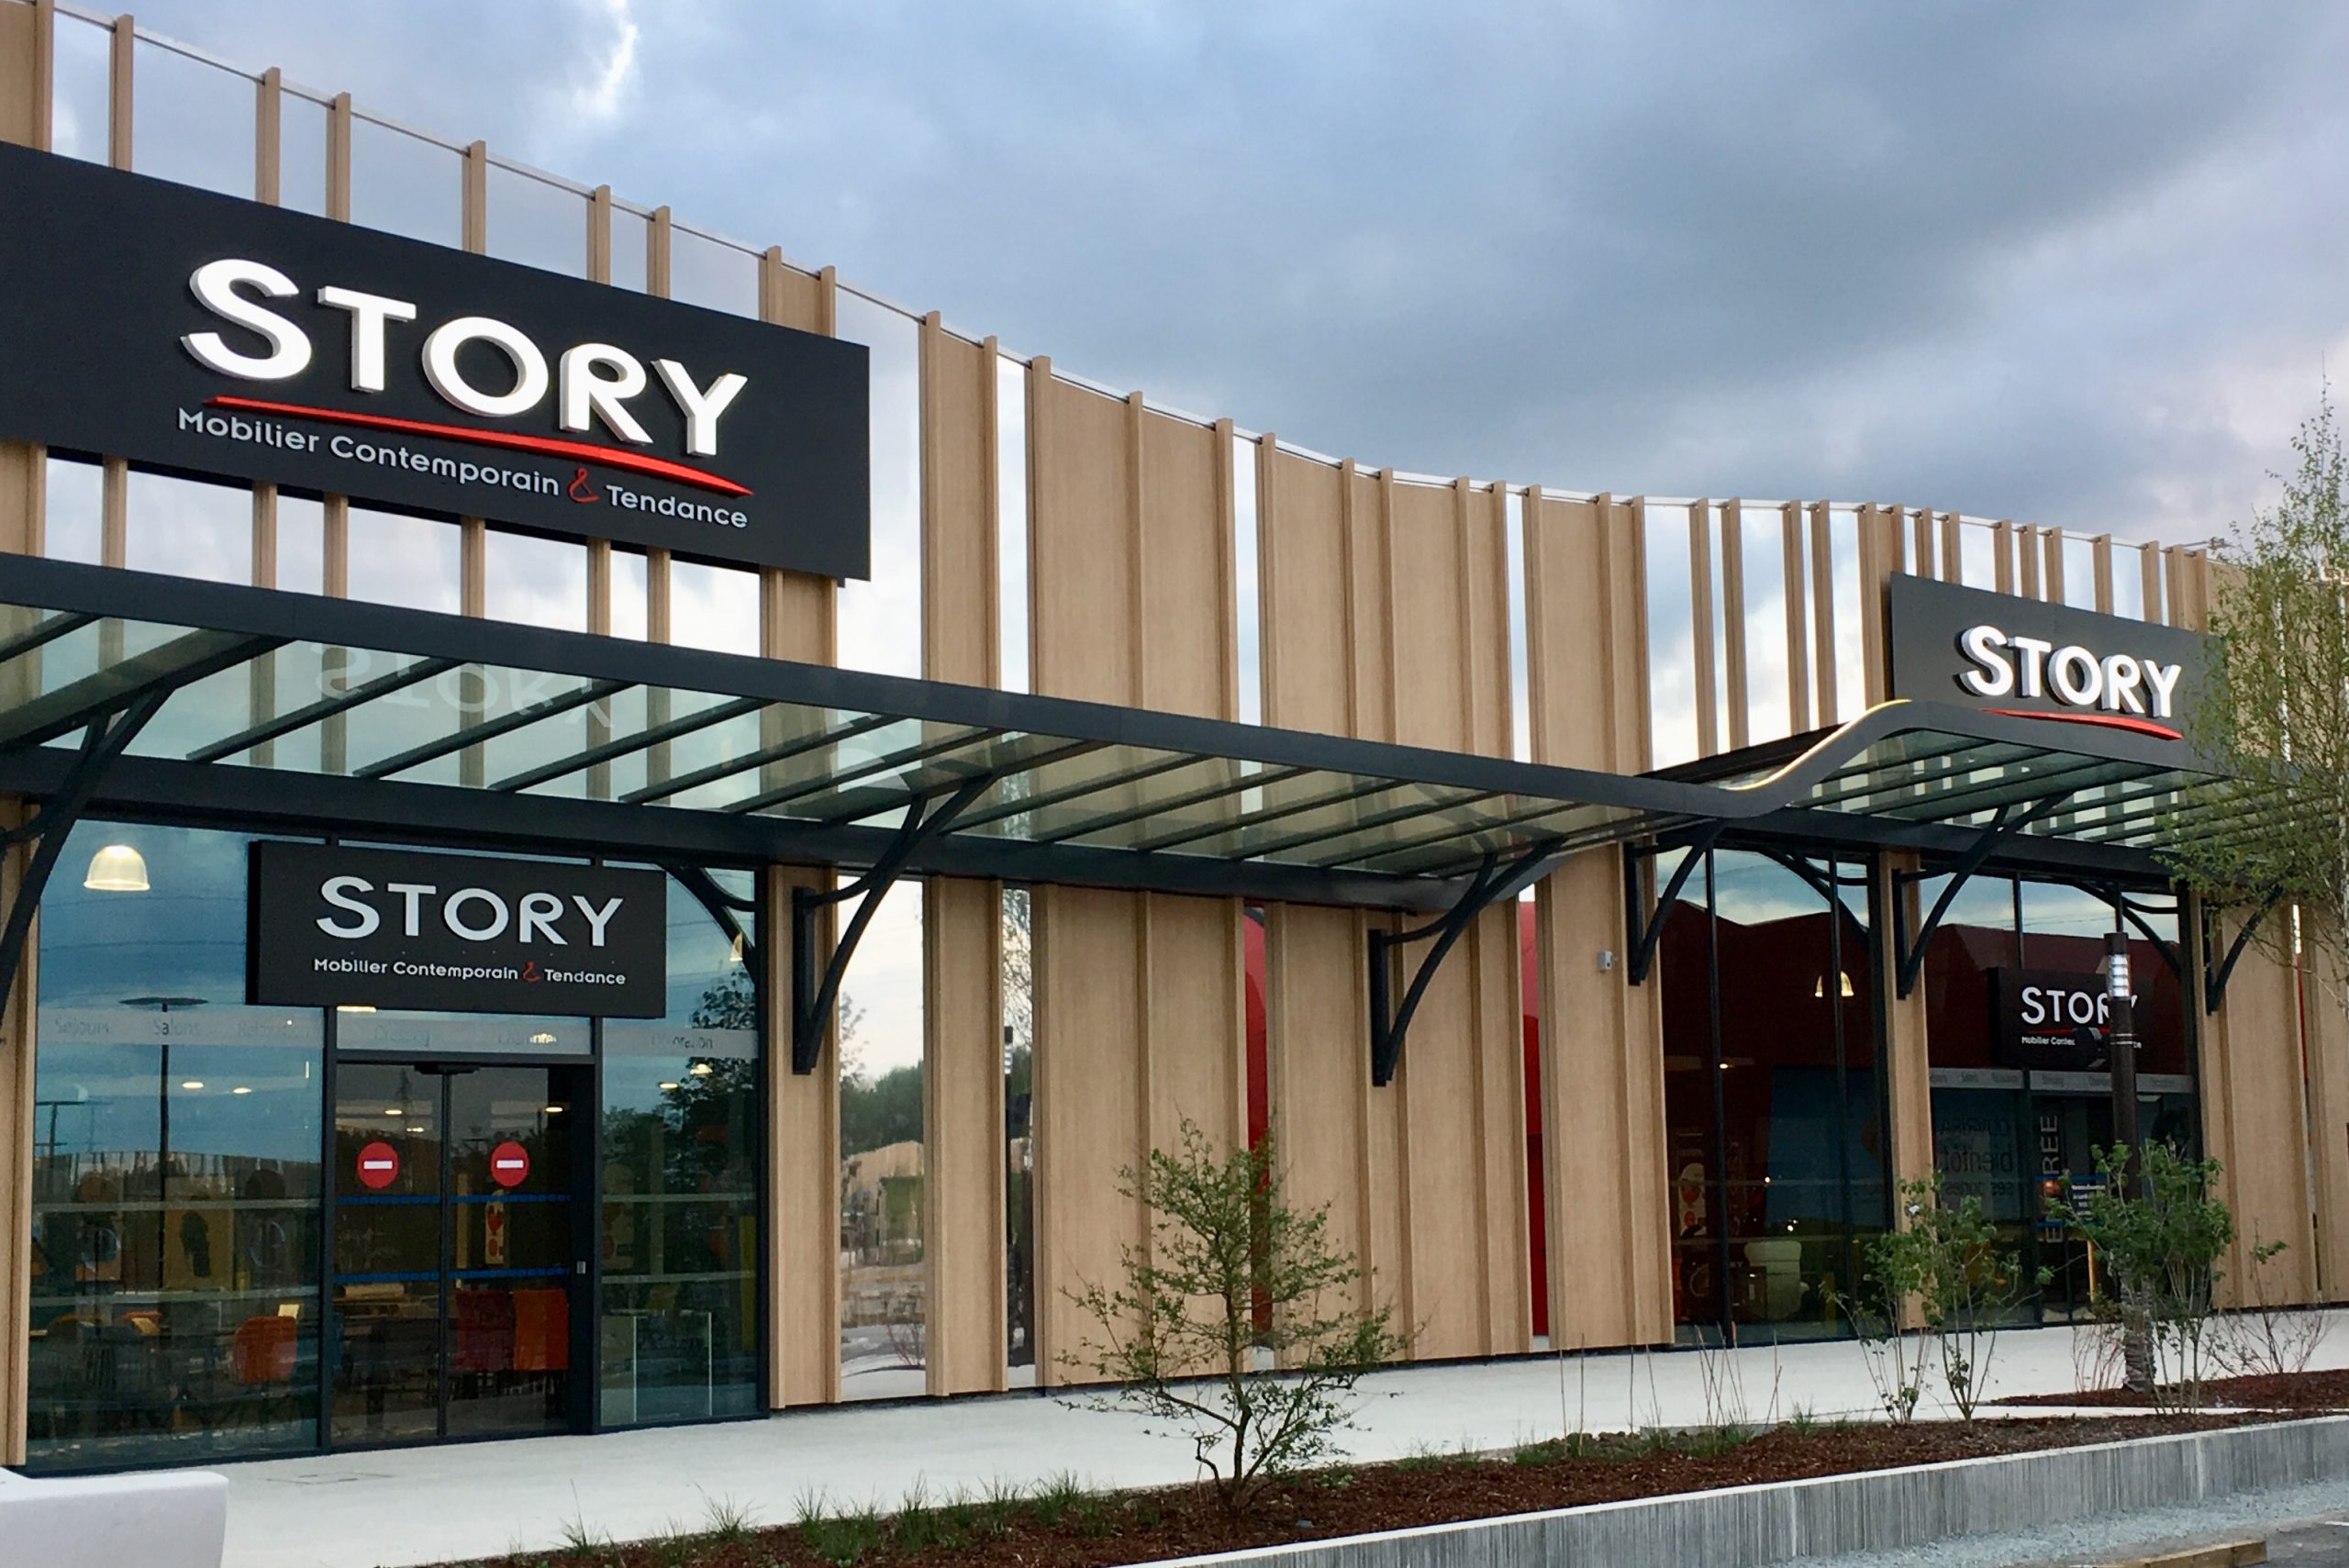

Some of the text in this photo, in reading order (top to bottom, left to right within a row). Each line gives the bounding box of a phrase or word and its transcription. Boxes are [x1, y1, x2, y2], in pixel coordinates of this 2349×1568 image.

[181, 258, 748, 457] STORY
[177, 407, 748, 529] Mobilier Contemporain & Tendance
[1960, 625, 2182, 718] STORY
[316, 875, 624, 947] STORY
[313, 958, 626, 985] Mobilier Contemporain & Tendance
[2021, 986, 2139, 1025] STOR
